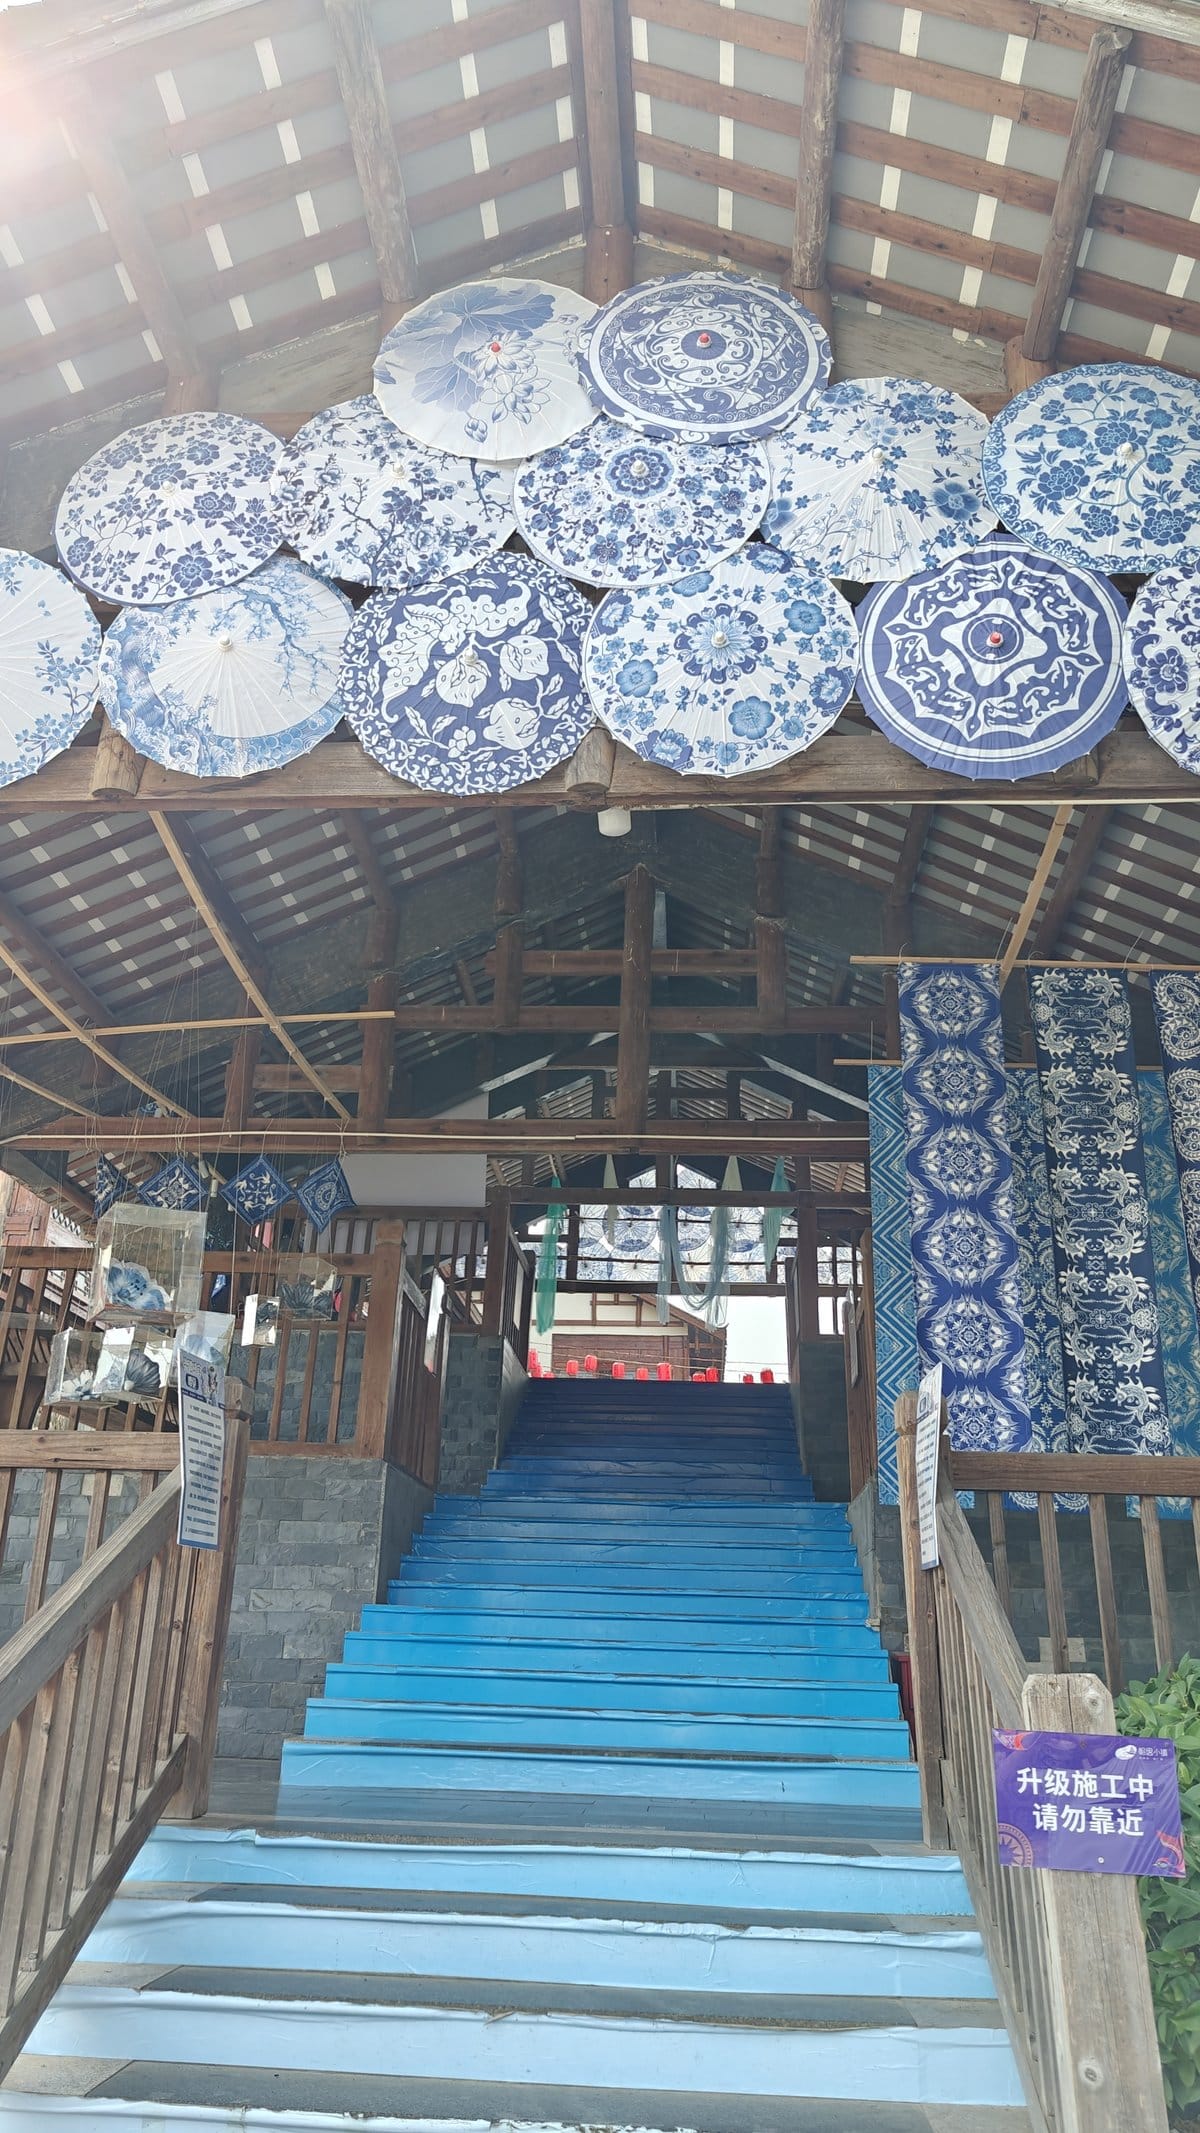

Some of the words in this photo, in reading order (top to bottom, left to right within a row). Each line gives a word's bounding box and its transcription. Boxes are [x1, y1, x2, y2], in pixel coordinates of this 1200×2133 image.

[1017, 1767, 1154, 1802] 升级施工中
[1032, 1803, 1144, 1837] 请勿靠近
